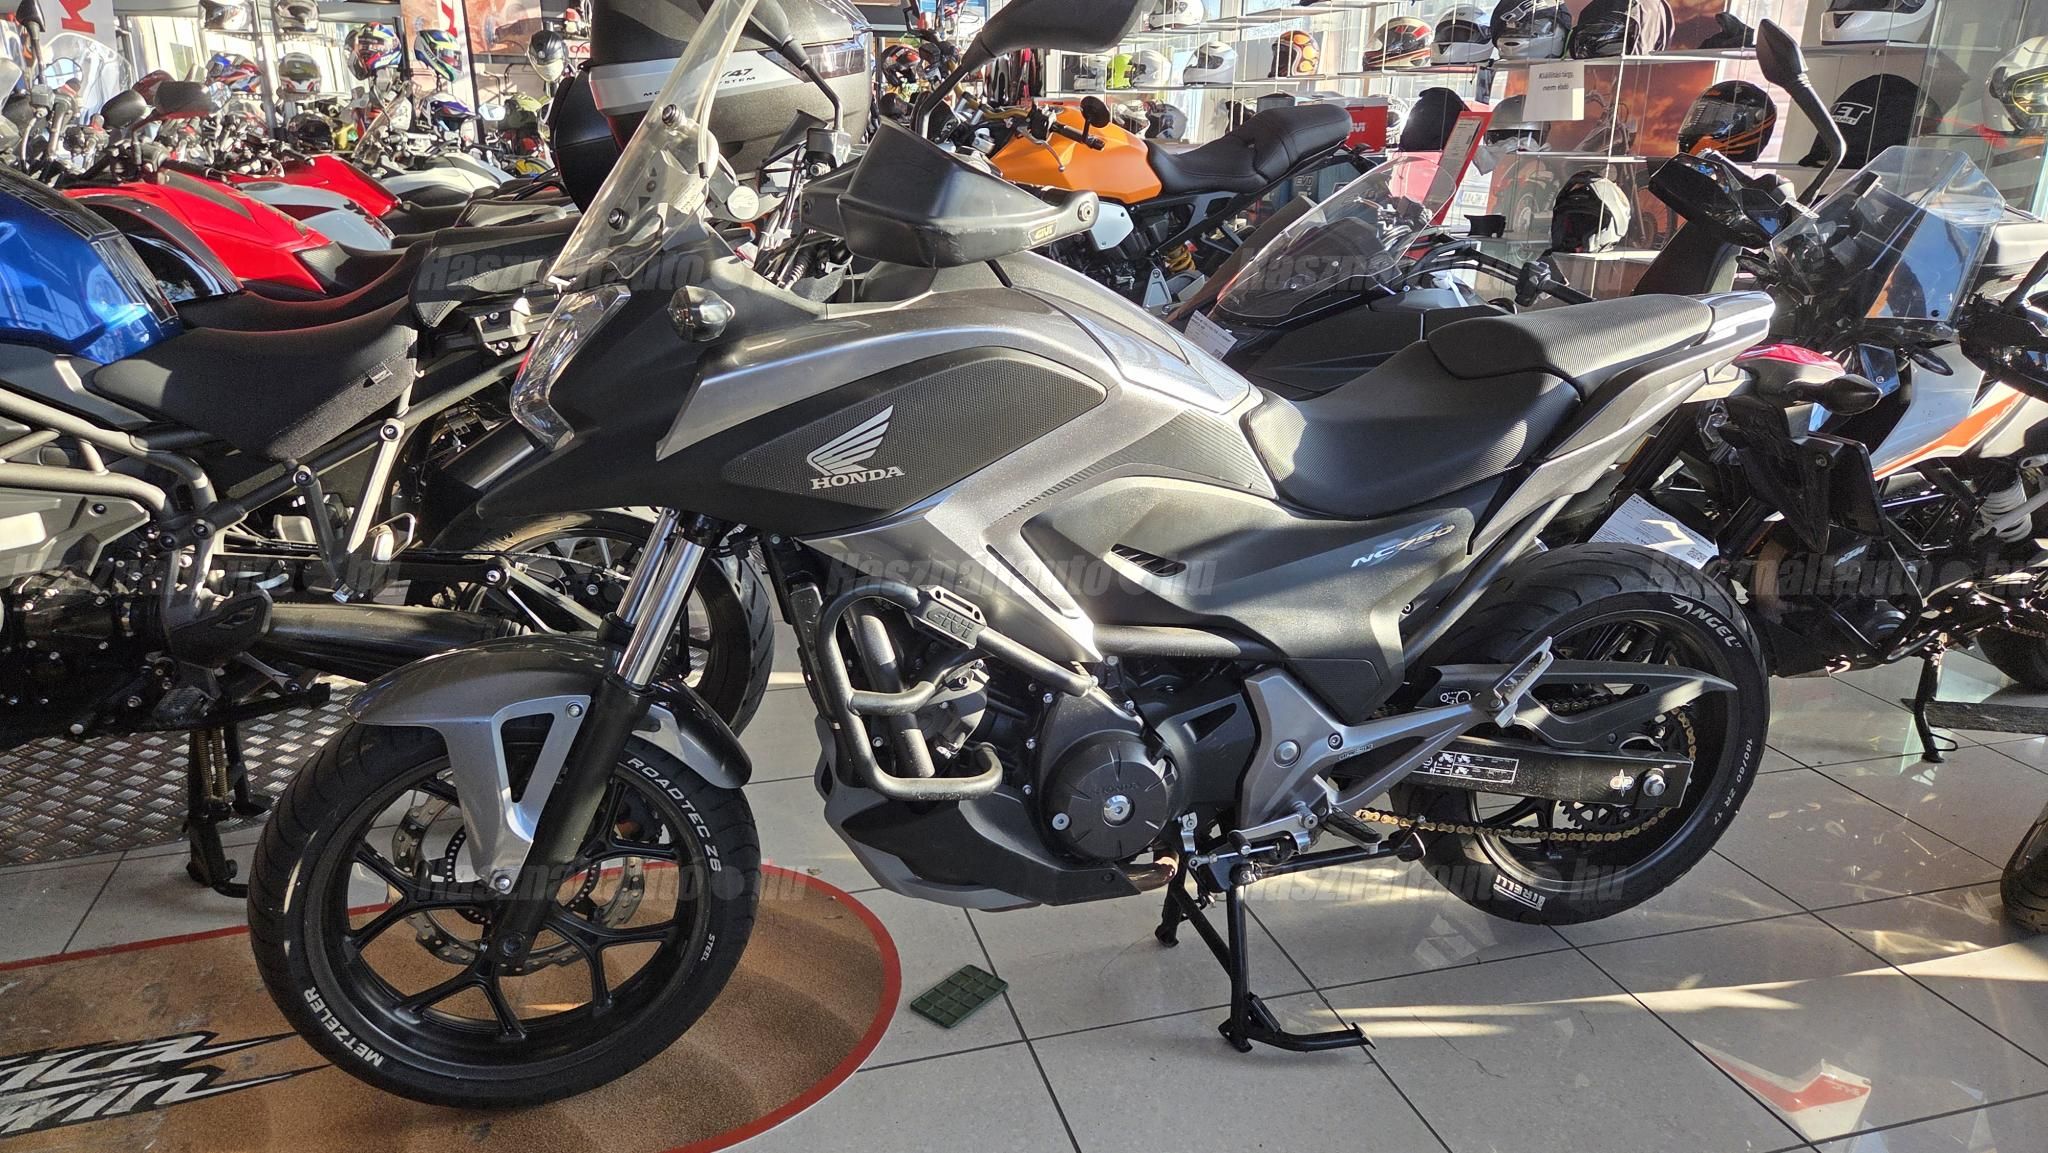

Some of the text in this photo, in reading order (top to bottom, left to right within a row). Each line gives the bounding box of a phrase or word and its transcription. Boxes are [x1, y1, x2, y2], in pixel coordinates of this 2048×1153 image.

[810, 466, 905, 490] HONDA
[1351, 524, 1456, 568] NC750
[627, 757, 722, 872] ROADTEC Z6
[1494, 874, 1546, 911] PIRELLI
[700, 932, 716, 962] STEEL
[303, 986, 385, 1068] METZELER
